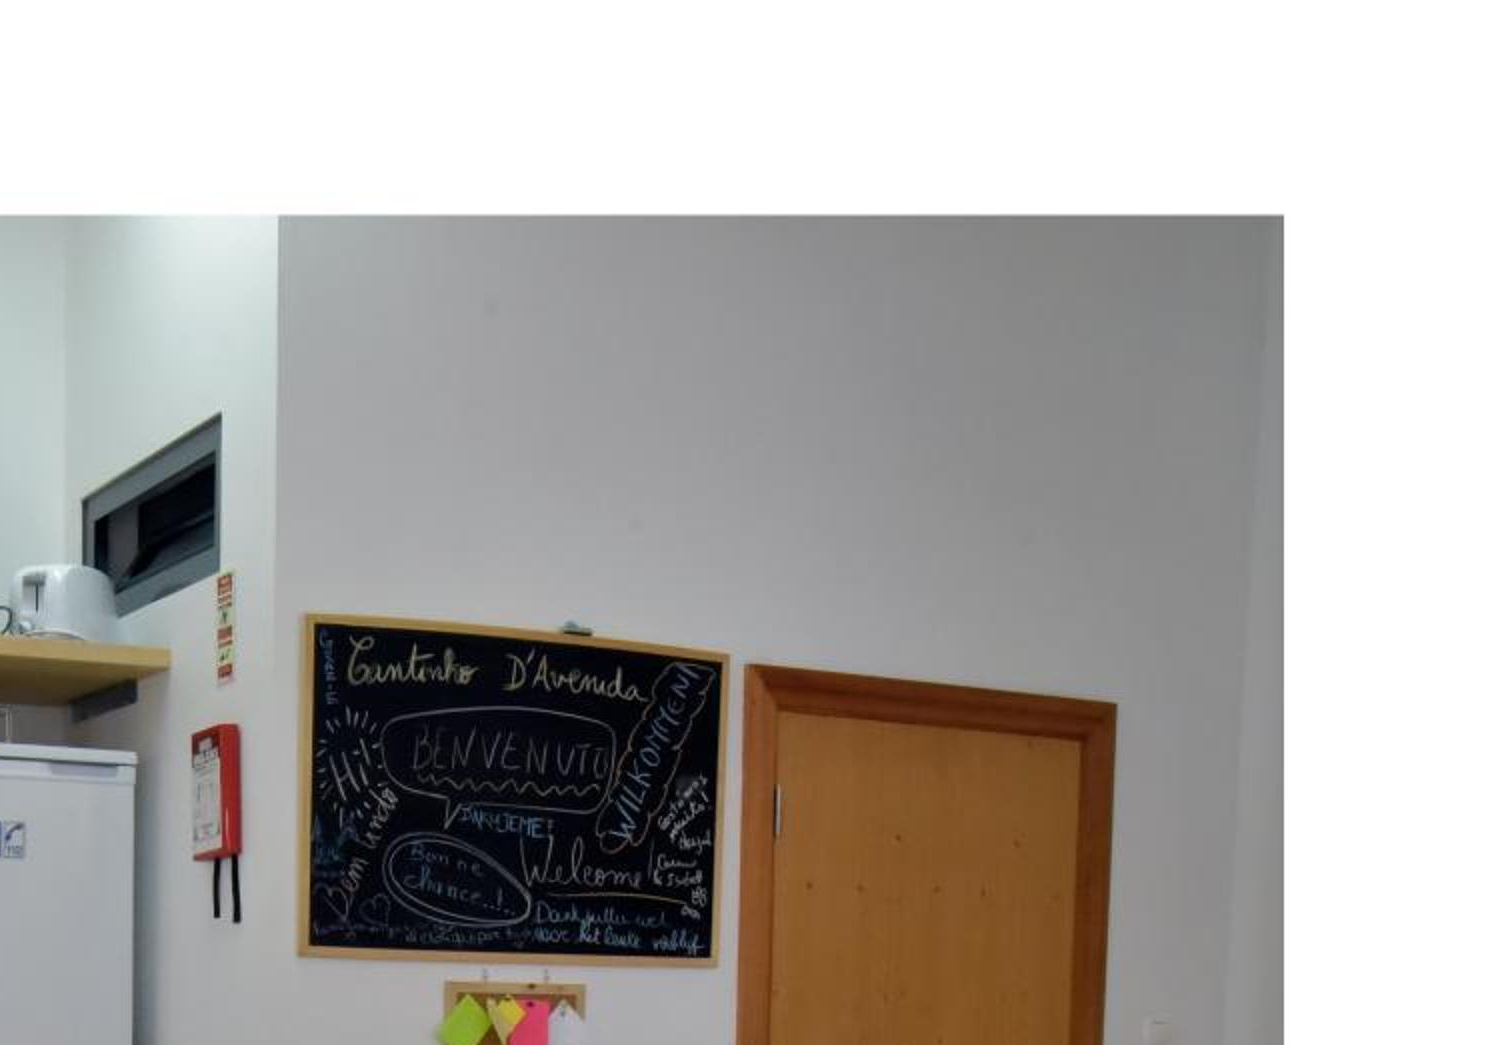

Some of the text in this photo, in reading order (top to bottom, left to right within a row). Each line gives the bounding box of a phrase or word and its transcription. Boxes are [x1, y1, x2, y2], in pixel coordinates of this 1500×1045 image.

[348, 635, 479, 686] Cantinho
[503, 649, 649, 702] D'Avenida
[411, 725, 607, 778] BENVENUTO
